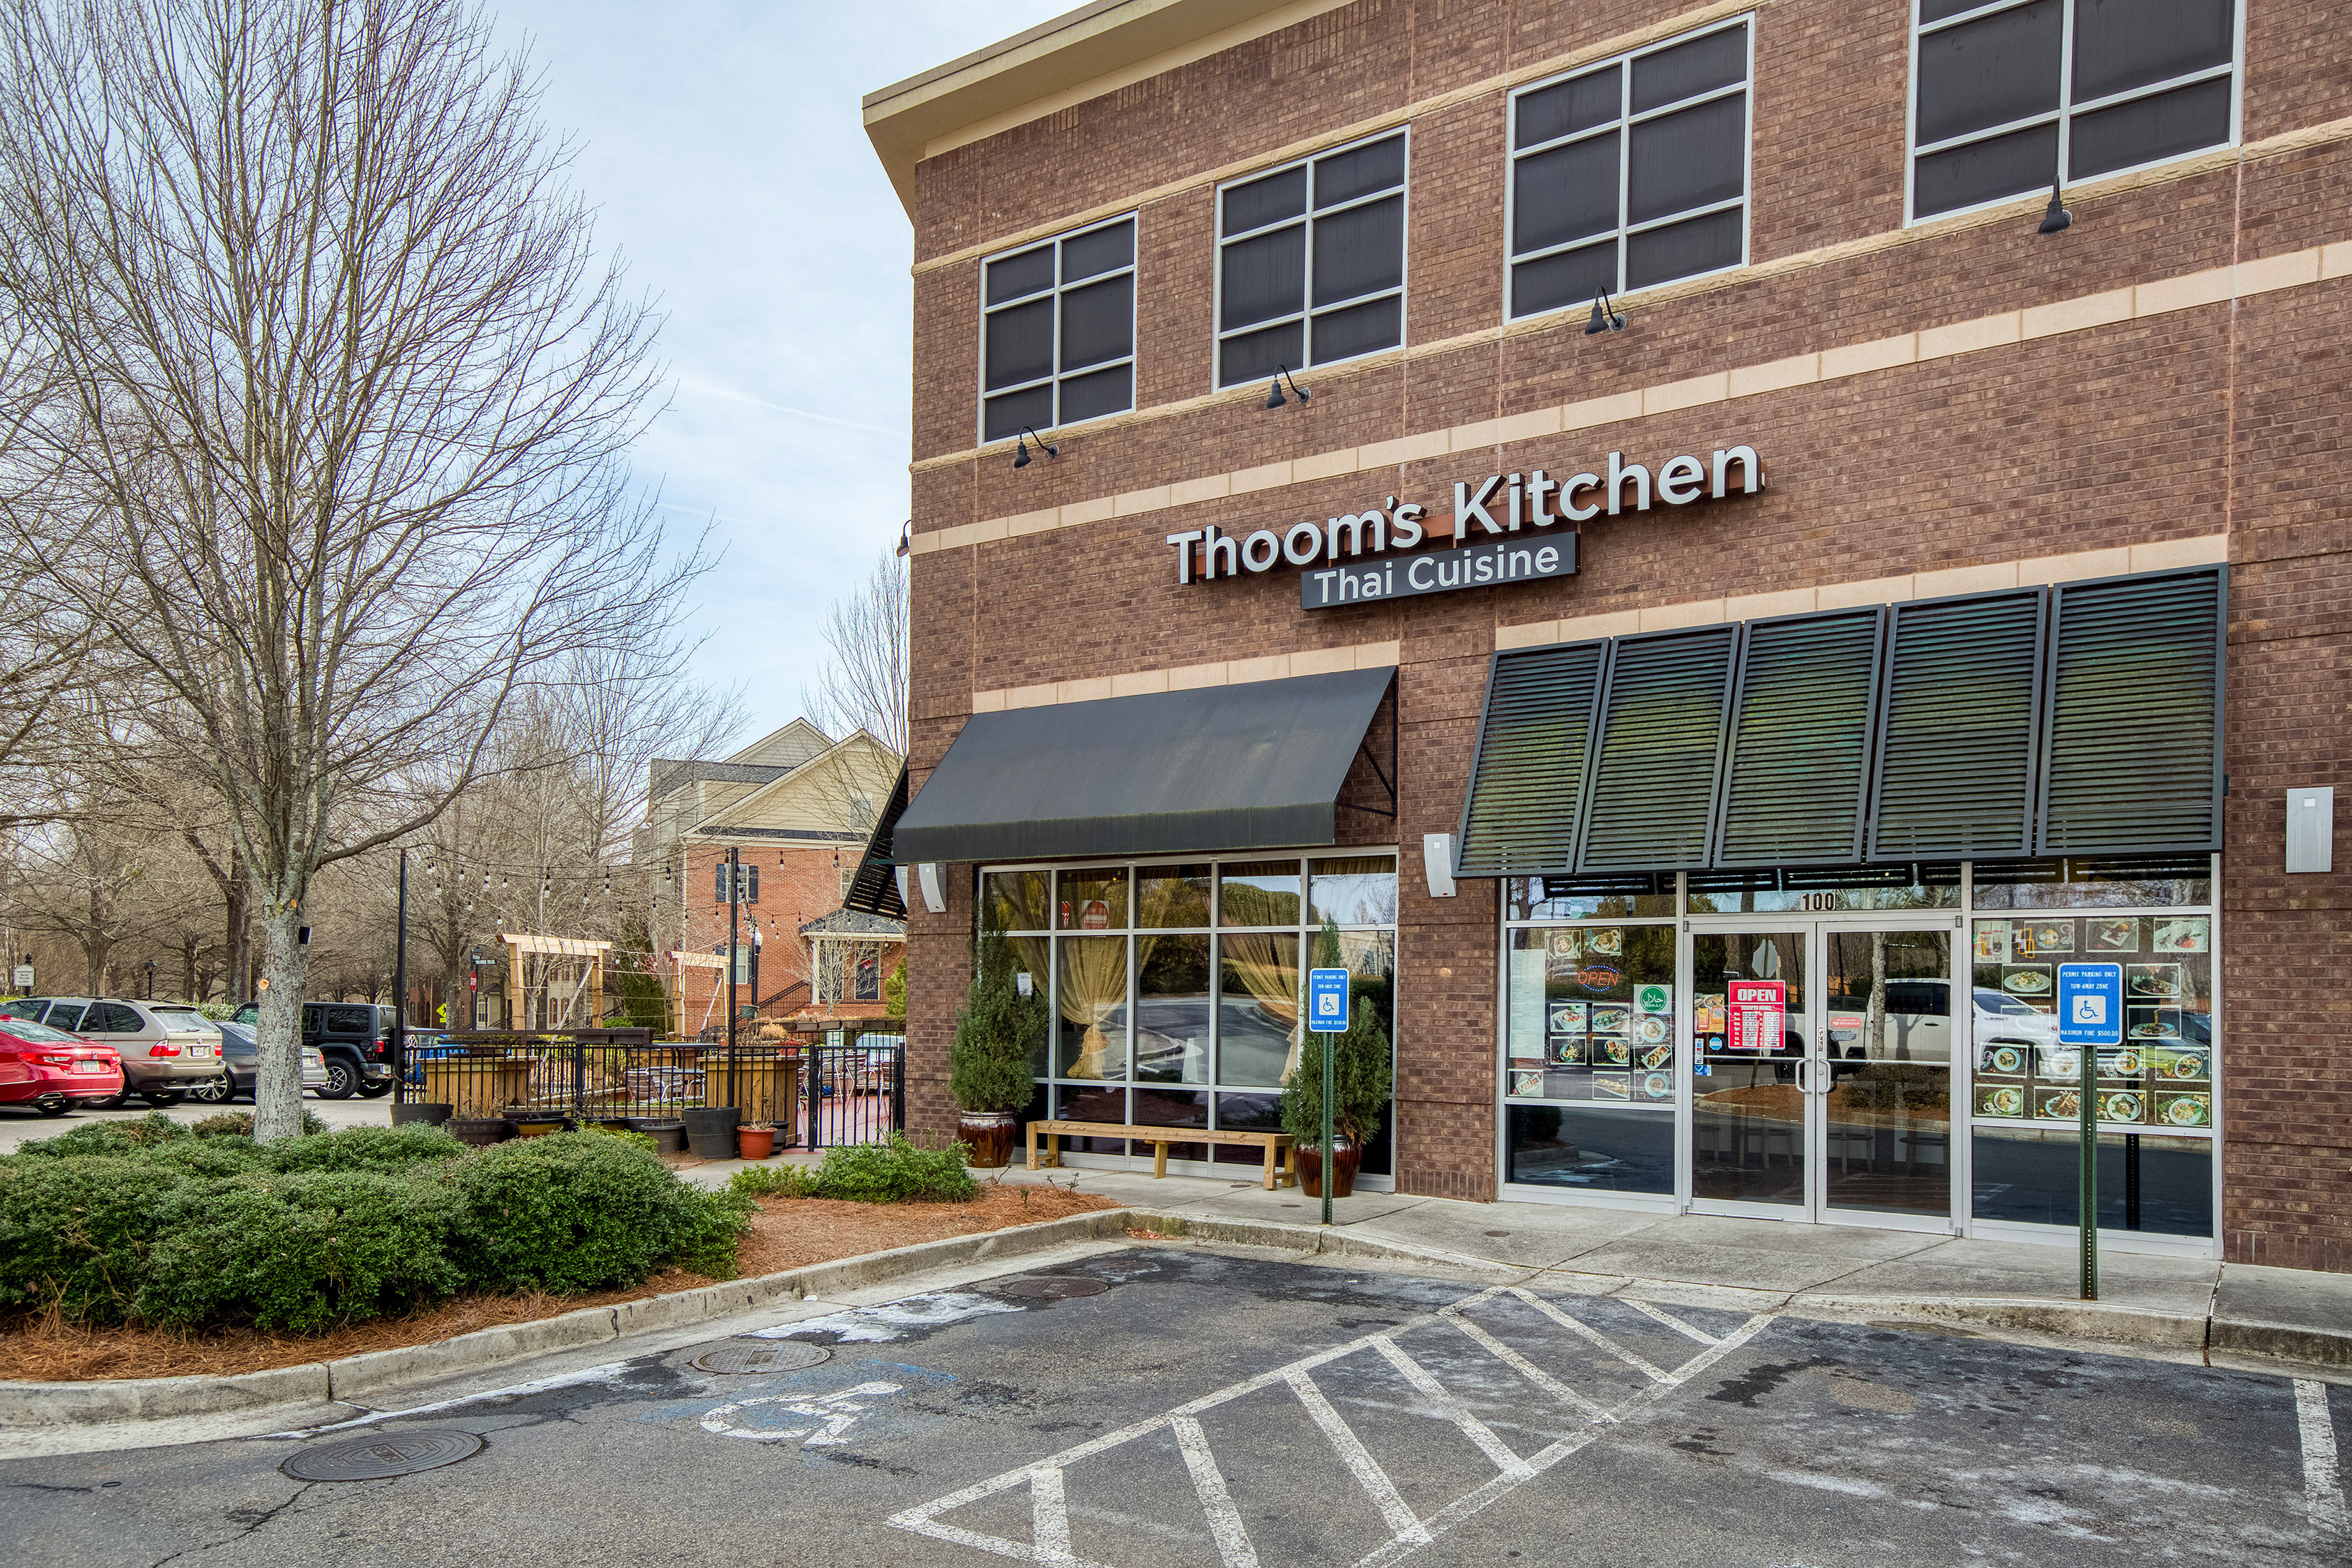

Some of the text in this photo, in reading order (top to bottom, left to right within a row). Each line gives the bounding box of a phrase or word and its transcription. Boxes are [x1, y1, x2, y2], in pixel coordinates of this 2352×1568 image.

[1166, 444, 1763, 585] Thoom's Kitchen
[1314, 545, 1559, 604] Thai Cuisine
[1802, 892, 1834, 911] 100
[1577, 971, 1619, 986] OPEN
[1737, 989, 1777, 1001] OPEN
